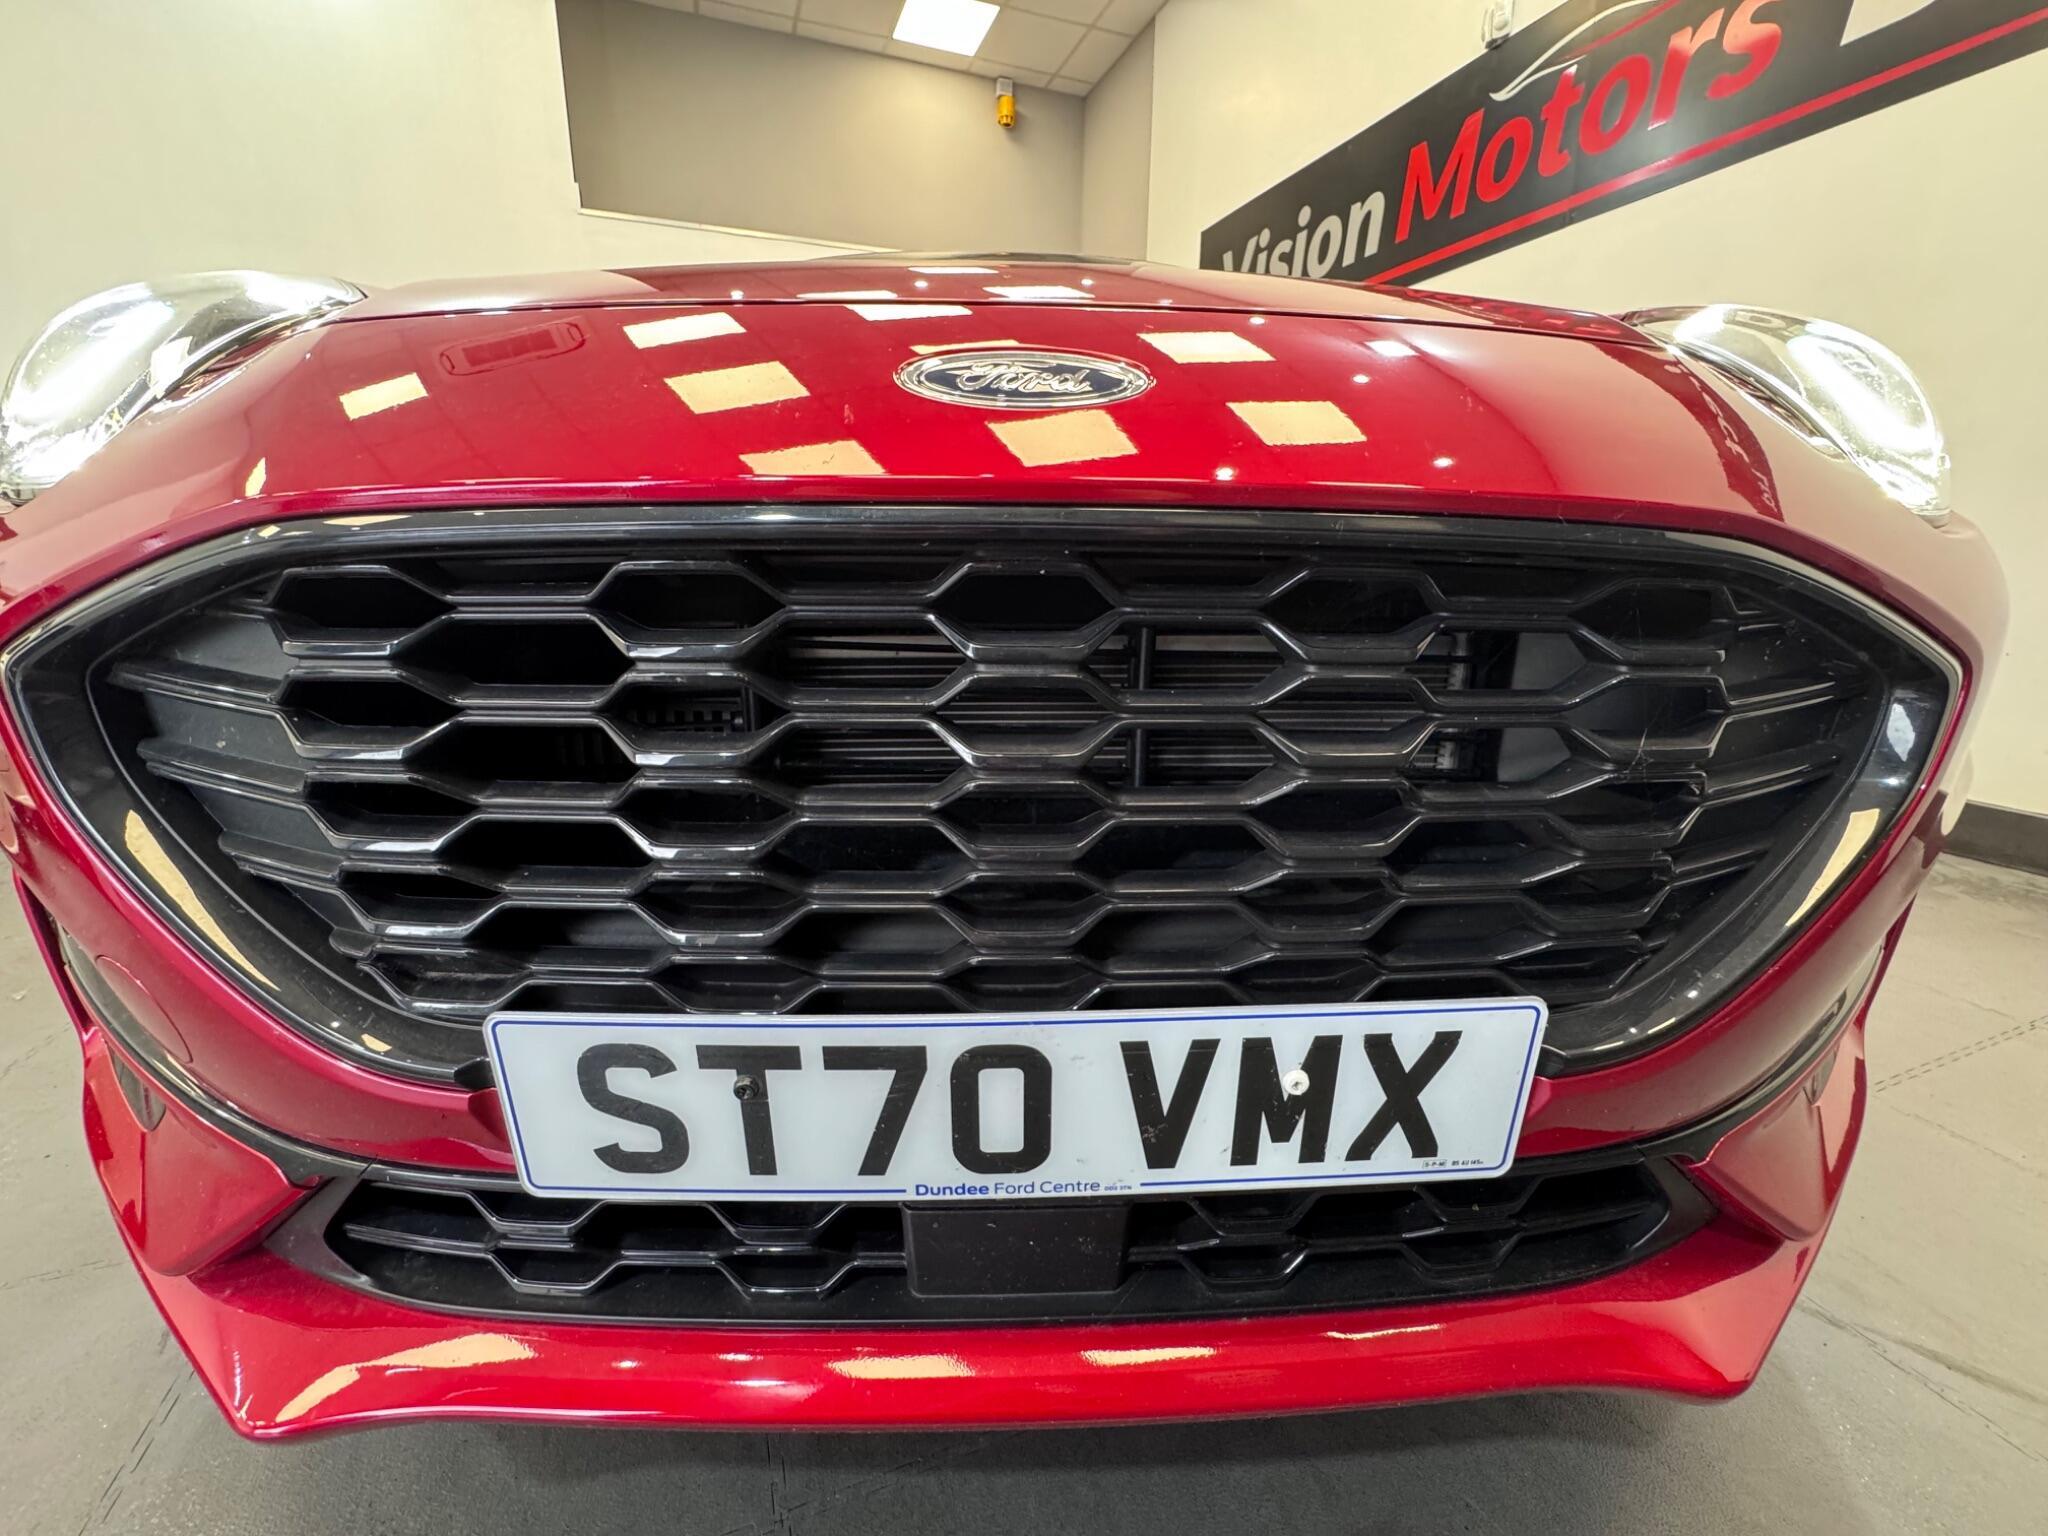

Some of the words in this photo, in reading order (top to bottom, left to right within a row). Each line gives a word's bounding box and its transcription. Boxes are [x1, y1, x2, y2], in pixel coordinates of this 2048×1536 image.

[1395, 0, 1782, 243] Motors
[951, 360, 1093, 393] Ford
[577, 1043, 1053, 1176] ST70
[1119, 1030, 1463, 1170] VMX
[915, 1183, 989, 1196] Dundee
[994, 1181, 1035, 1195] Ford
[1039, 1179, 1100, 1194] Centre
